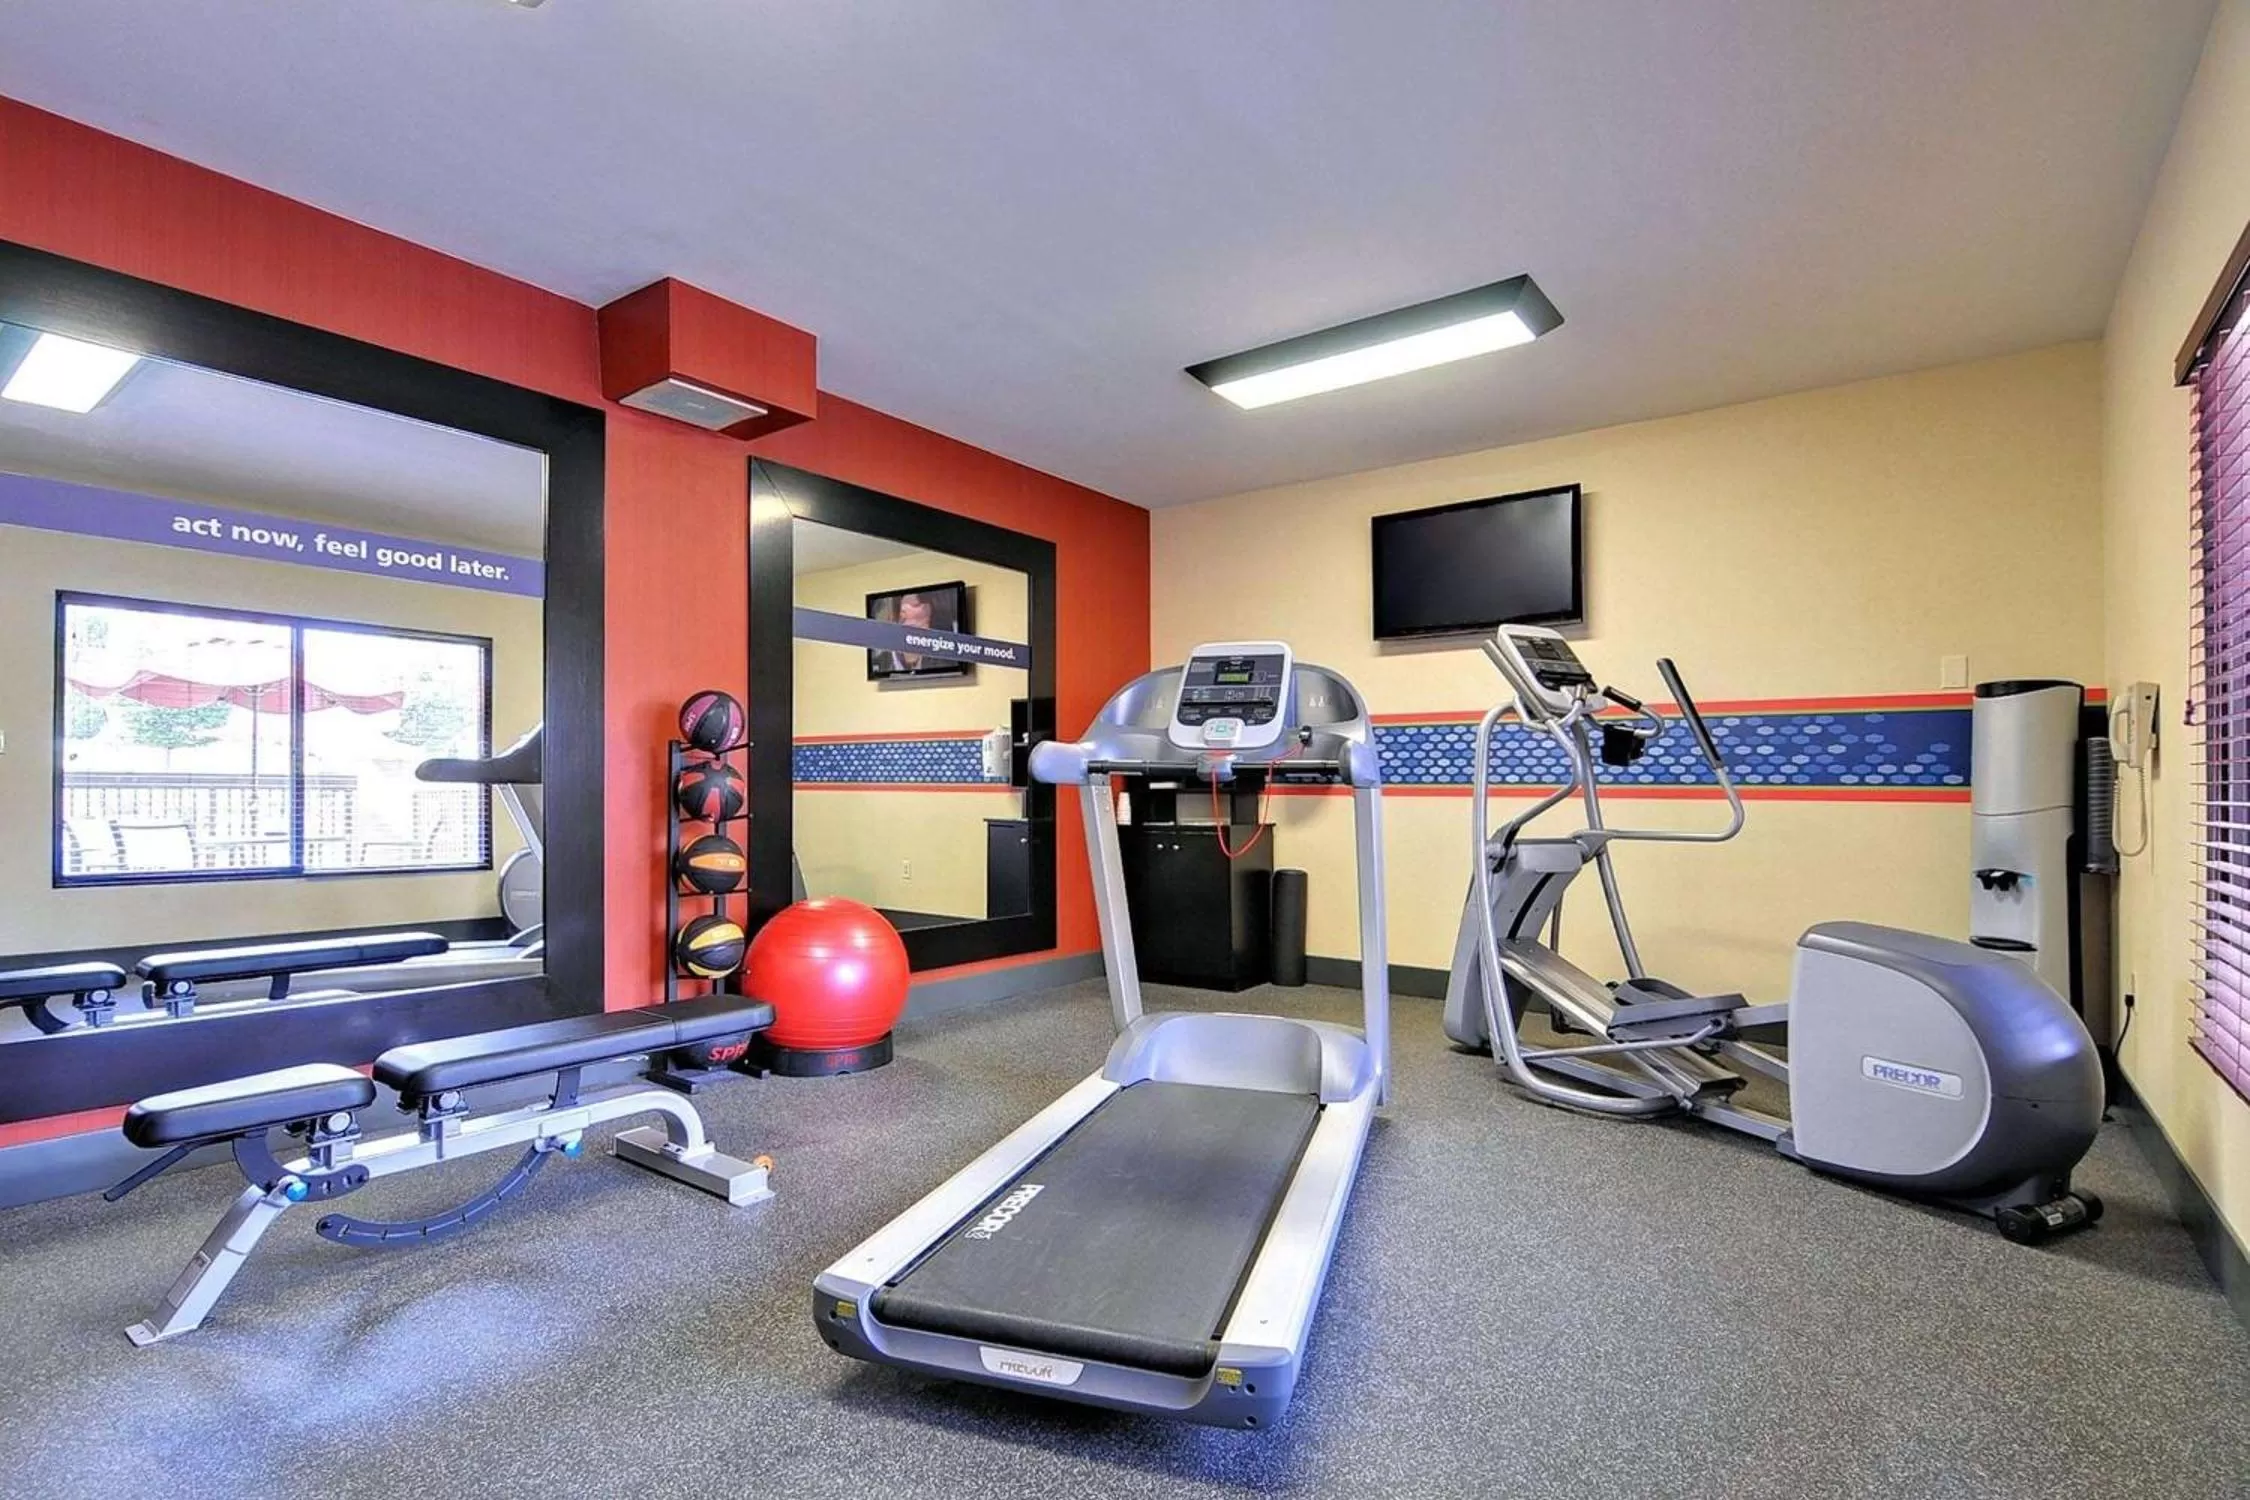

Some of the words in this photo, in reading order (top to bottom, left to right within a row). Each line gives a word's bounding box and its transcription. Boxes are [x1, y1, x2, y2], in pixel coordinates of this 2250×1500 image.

[171, 516, 222, 538] act
[231, 525, 304, 552] now,
[313, 533, 368, 559] feel
[376, 547, 443, 571] good
[449, 554, 510, 581] later.
[905, 634, 955, 652] energize
[956, 641, 982, 655] your
[983, 647, 1017, 660] mood.
[708, 1041, 750, 1061] SPR
[1872, 1064, 1941, 1089] PRECOR
[976, 1184, 1045, 1233] PRECOR
